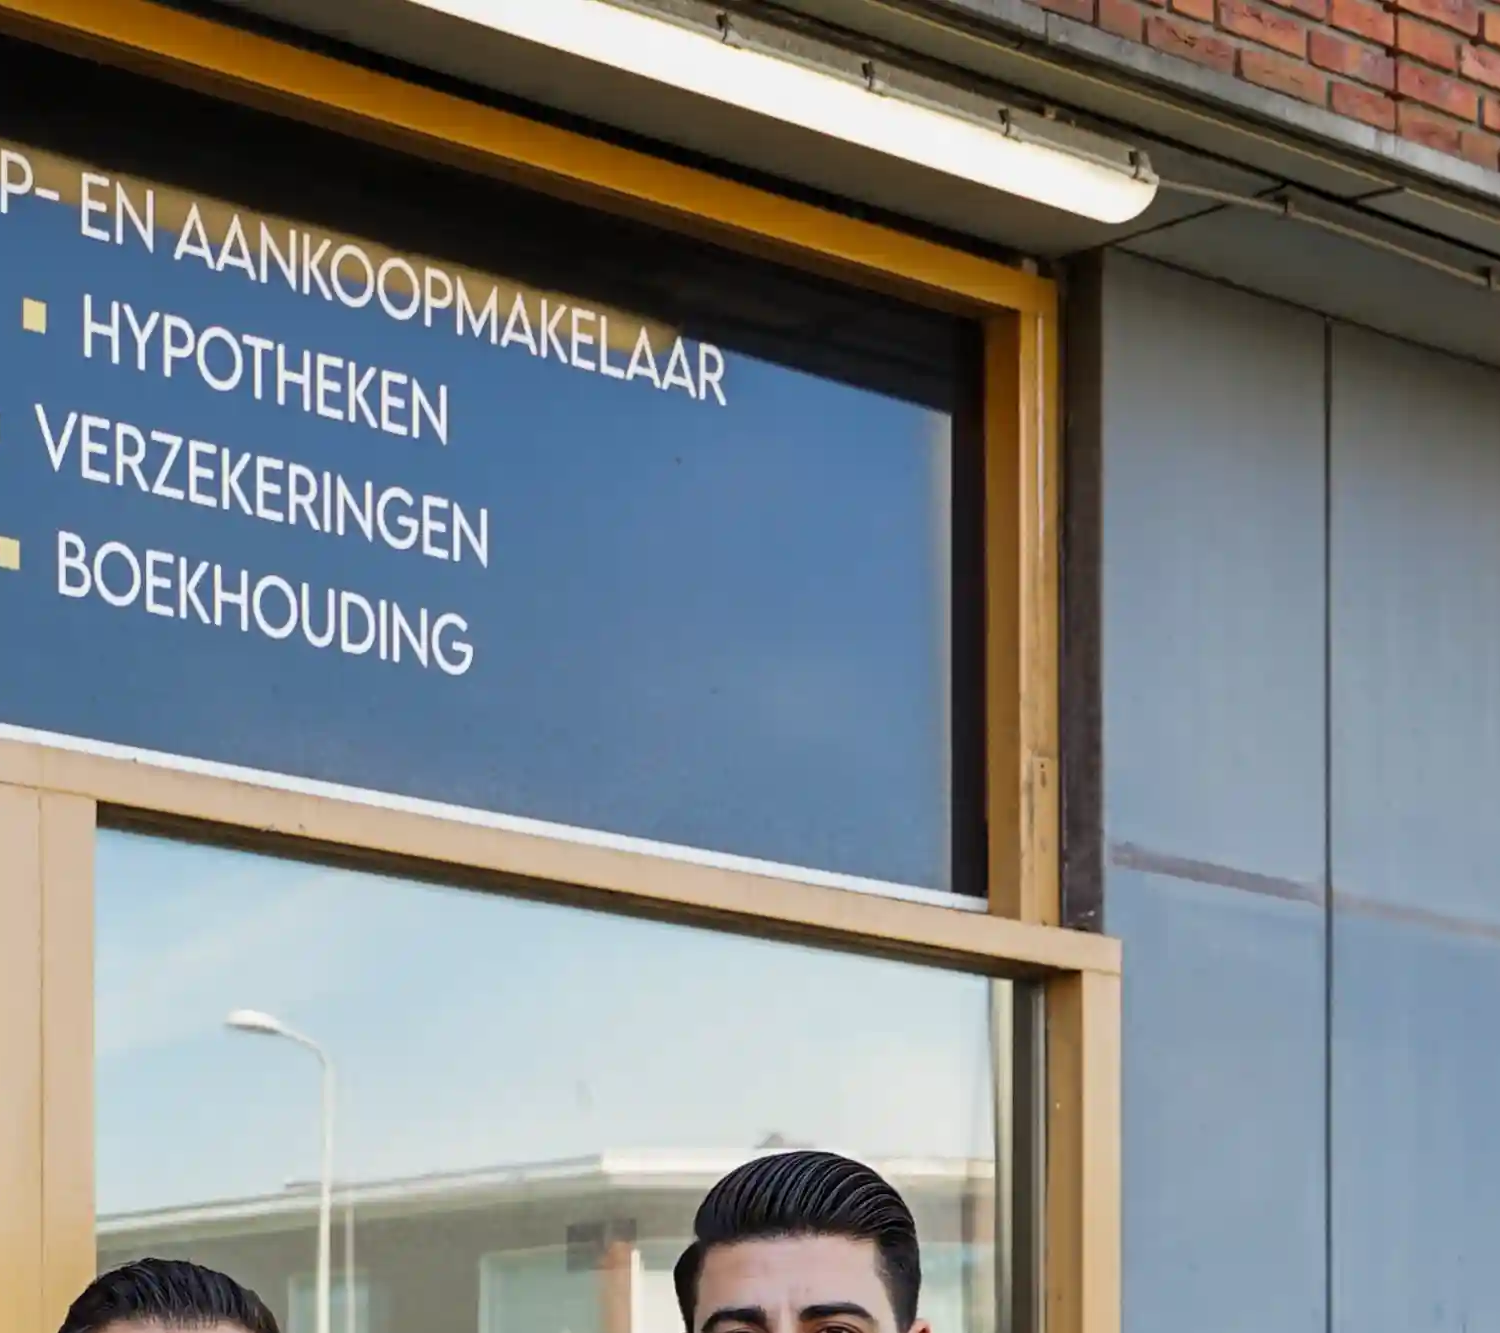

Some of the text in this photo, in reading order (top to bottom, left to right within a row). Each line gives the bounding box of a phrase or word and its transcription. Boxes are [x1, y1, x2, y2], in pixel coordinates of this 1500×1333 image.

[80, 172, 156, 254] EN
[174, 208, 728, 408] AANKOOPMAKELAAR
[82, 295, 450, 448] HYPOTHEKEN
[34, 402, 490, 570] VERZEKERINGEN
[56, 532, 476, 678] BOEKHOUDING
